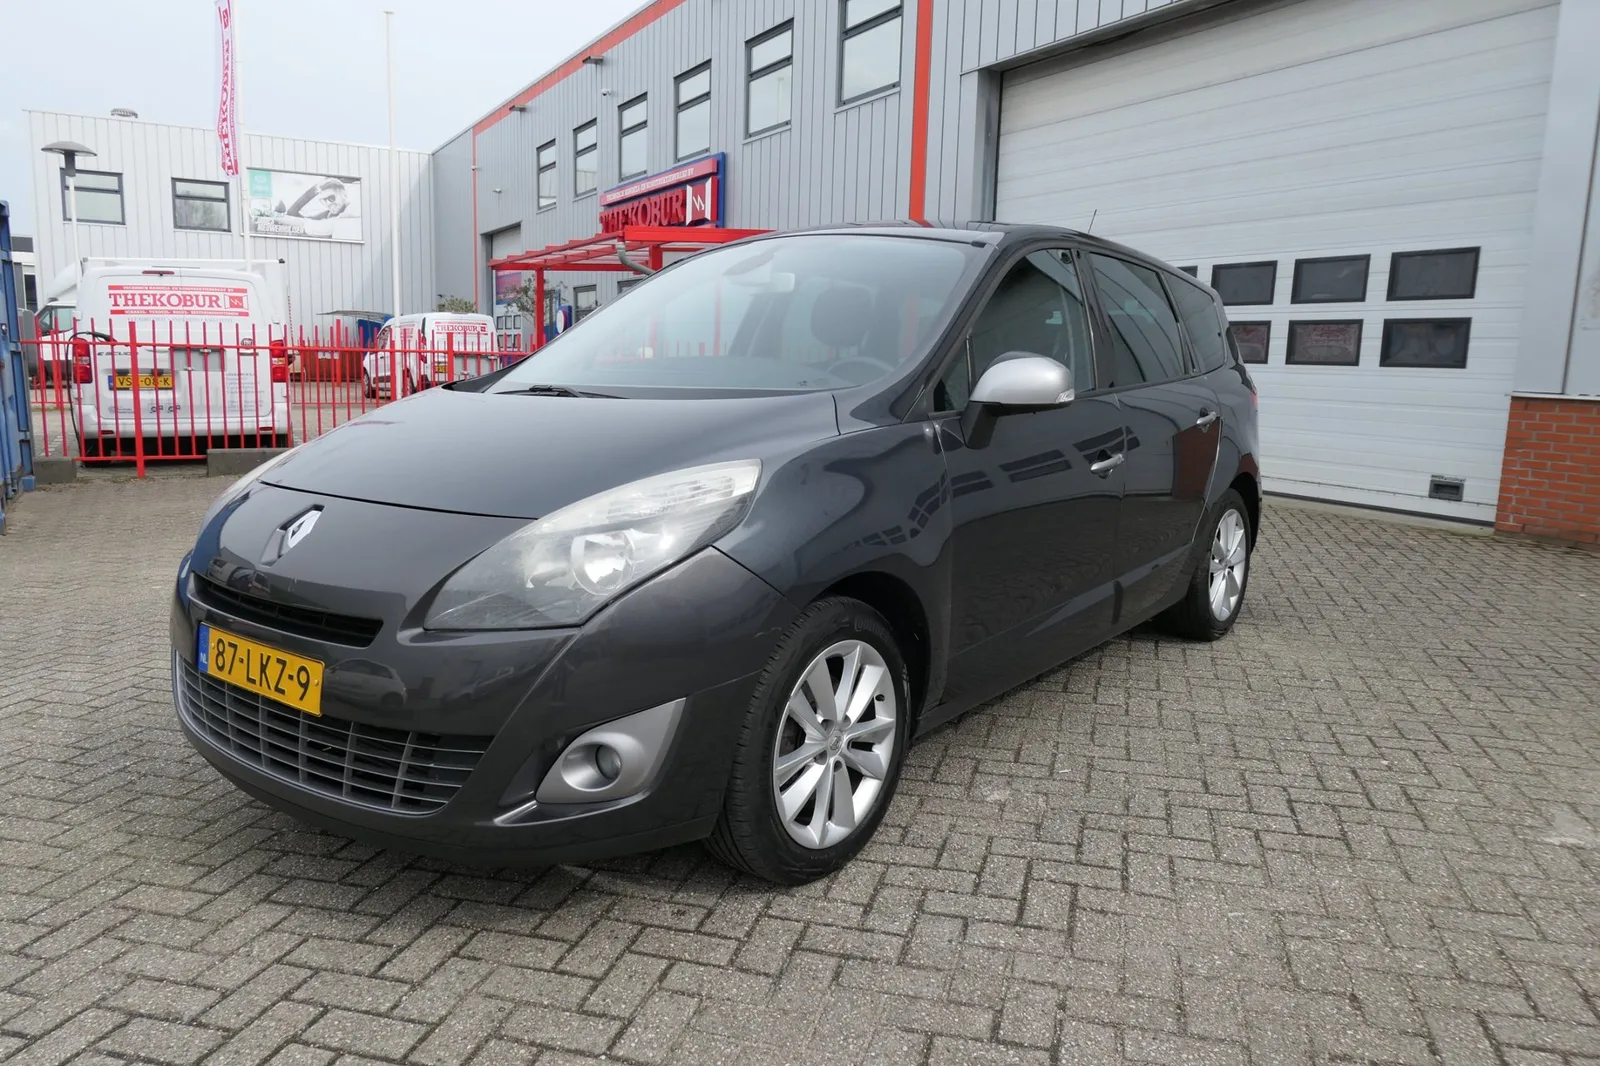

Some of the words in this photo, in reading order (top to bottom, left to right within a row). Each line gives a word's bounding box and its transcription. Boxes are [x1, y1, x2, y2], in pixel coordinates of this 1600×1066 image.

[600, 190, 685, 233] THEKOBUR
[108, 293, 222, 308] THEKOBUR
[118, 377, 170, 386] VS-08-K
[215, 637, 311, 701] 87-LKZ-9
